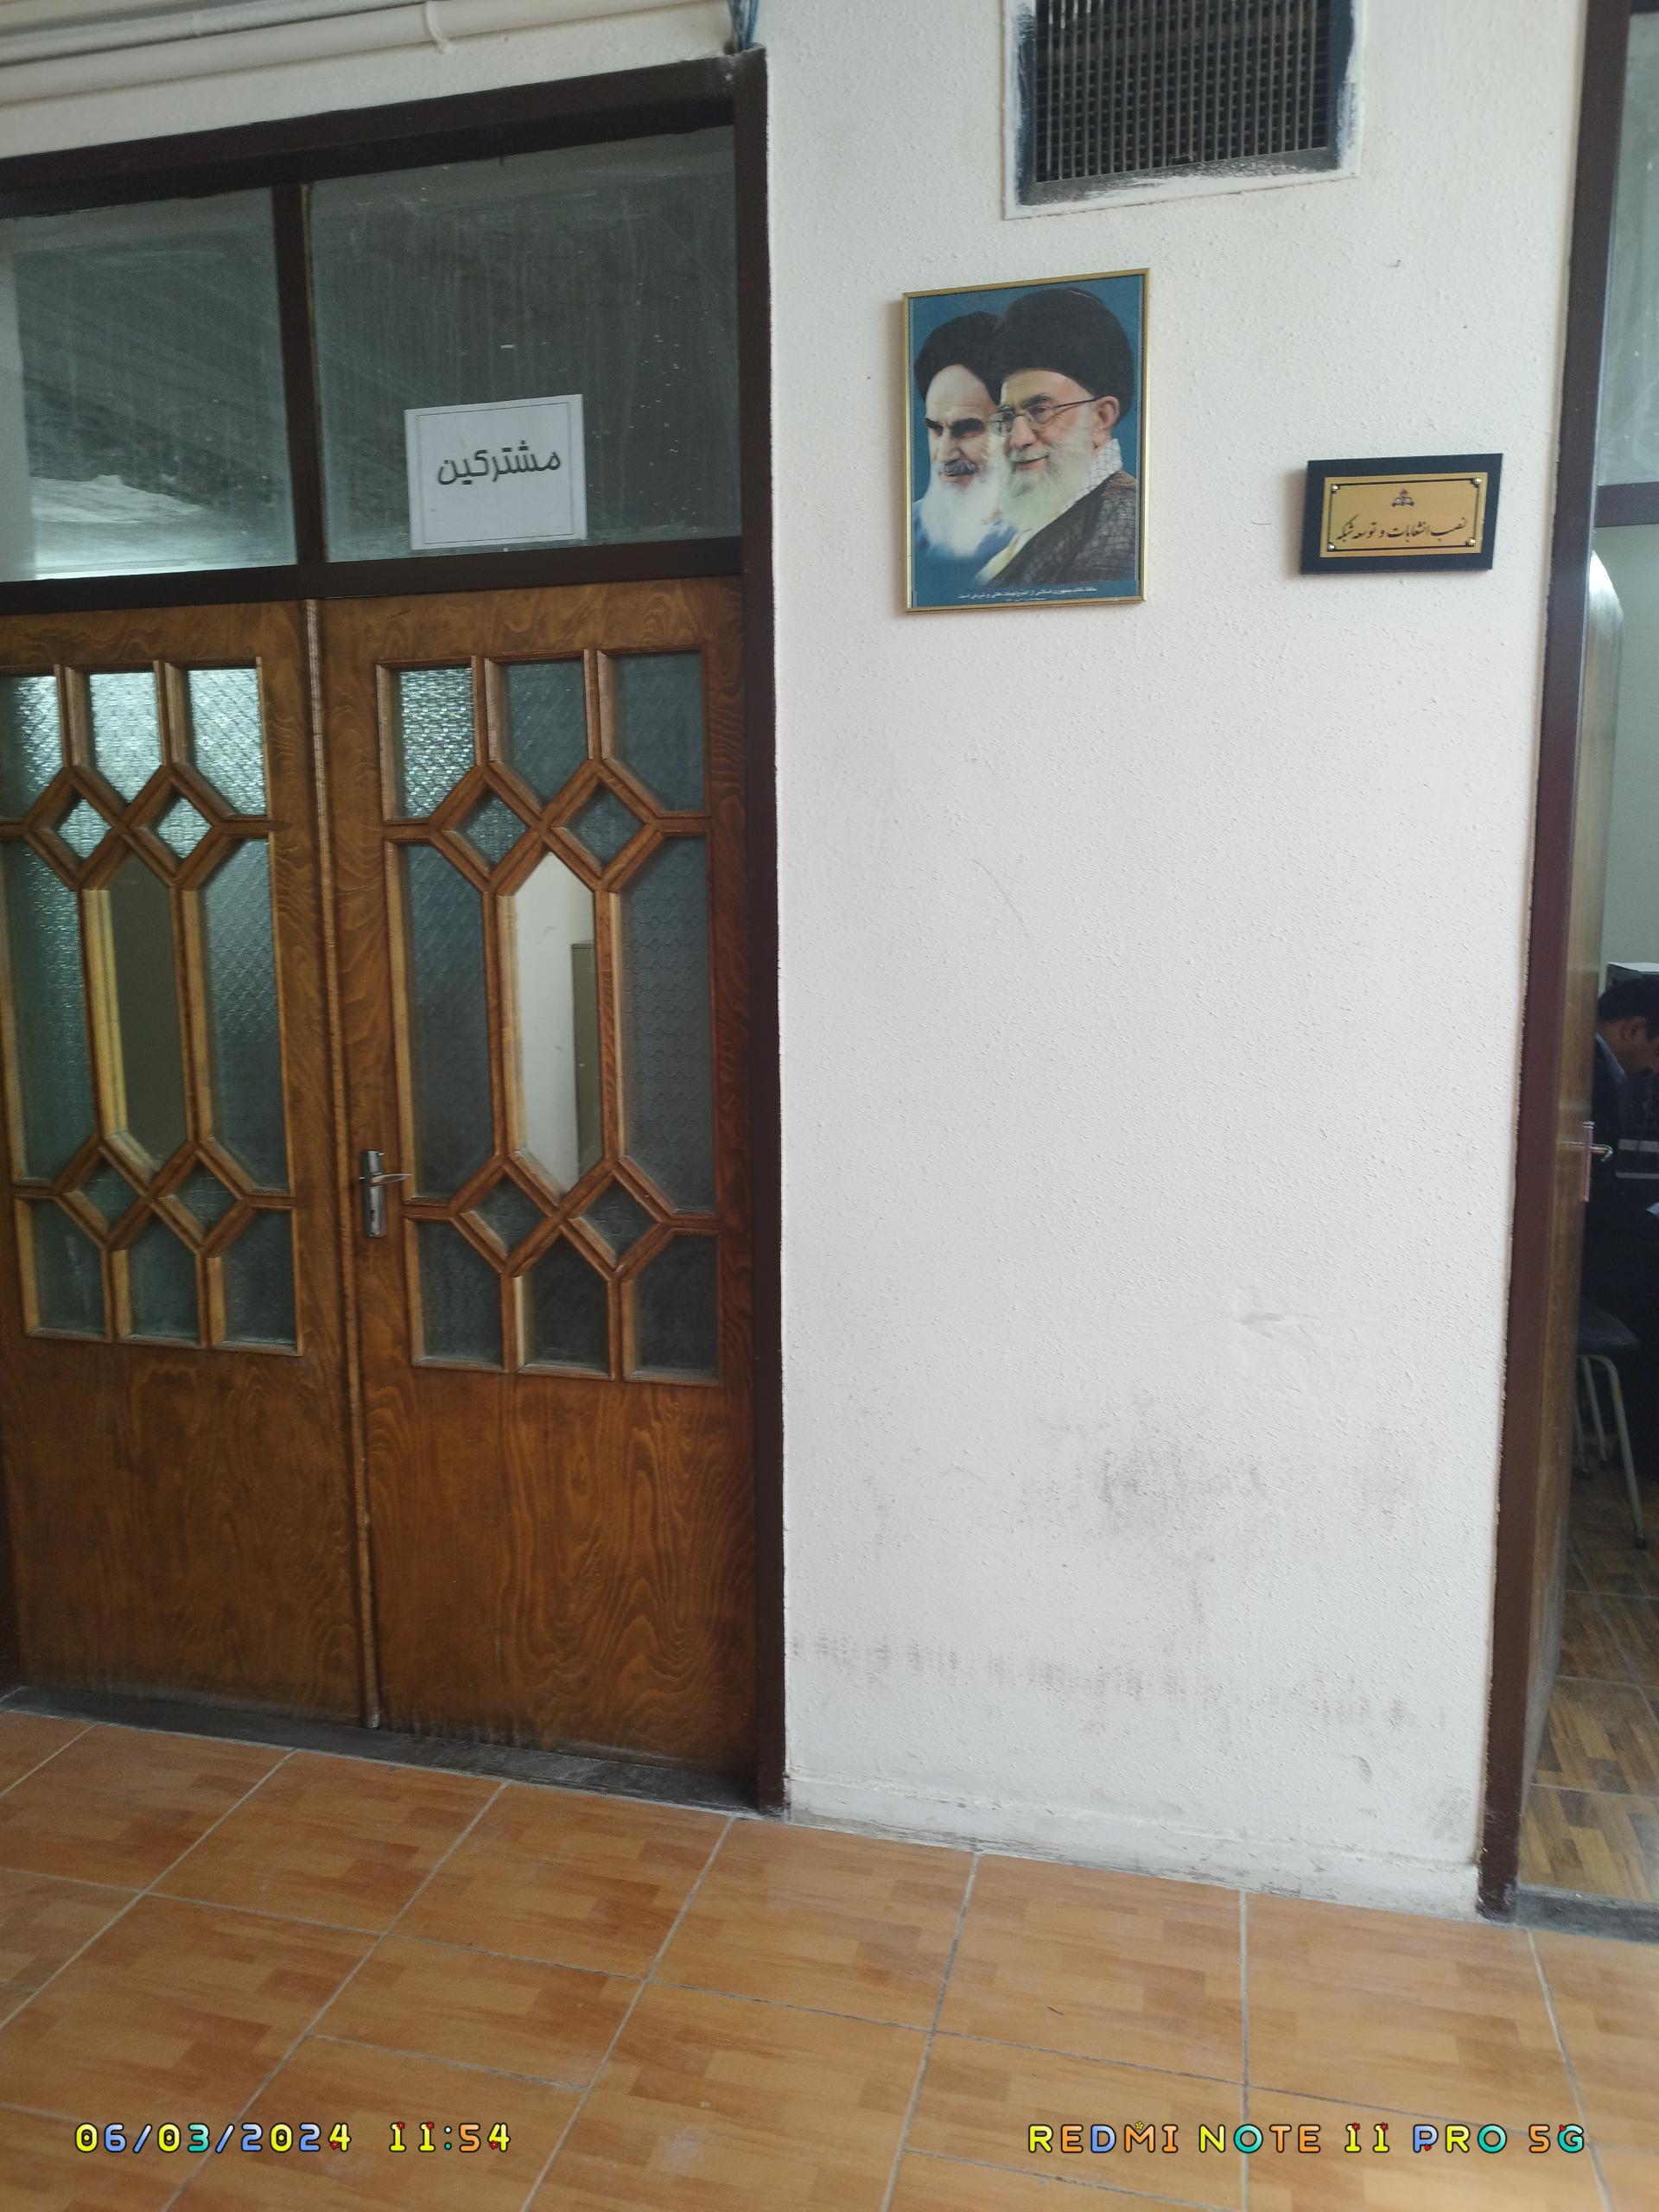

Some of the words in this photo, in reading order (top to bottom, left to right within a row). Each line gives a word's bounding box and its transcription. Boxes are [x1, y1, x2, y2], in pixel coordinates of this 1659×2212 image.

[437, 440, 562, 486] مشترکین
[1351, 521, 1377, 540] توسعه
[1378, 529, 1385, 539] و
[1387, 520, 1431, 543] انشعابات
[1430, 517, 1468, 542] نصب
